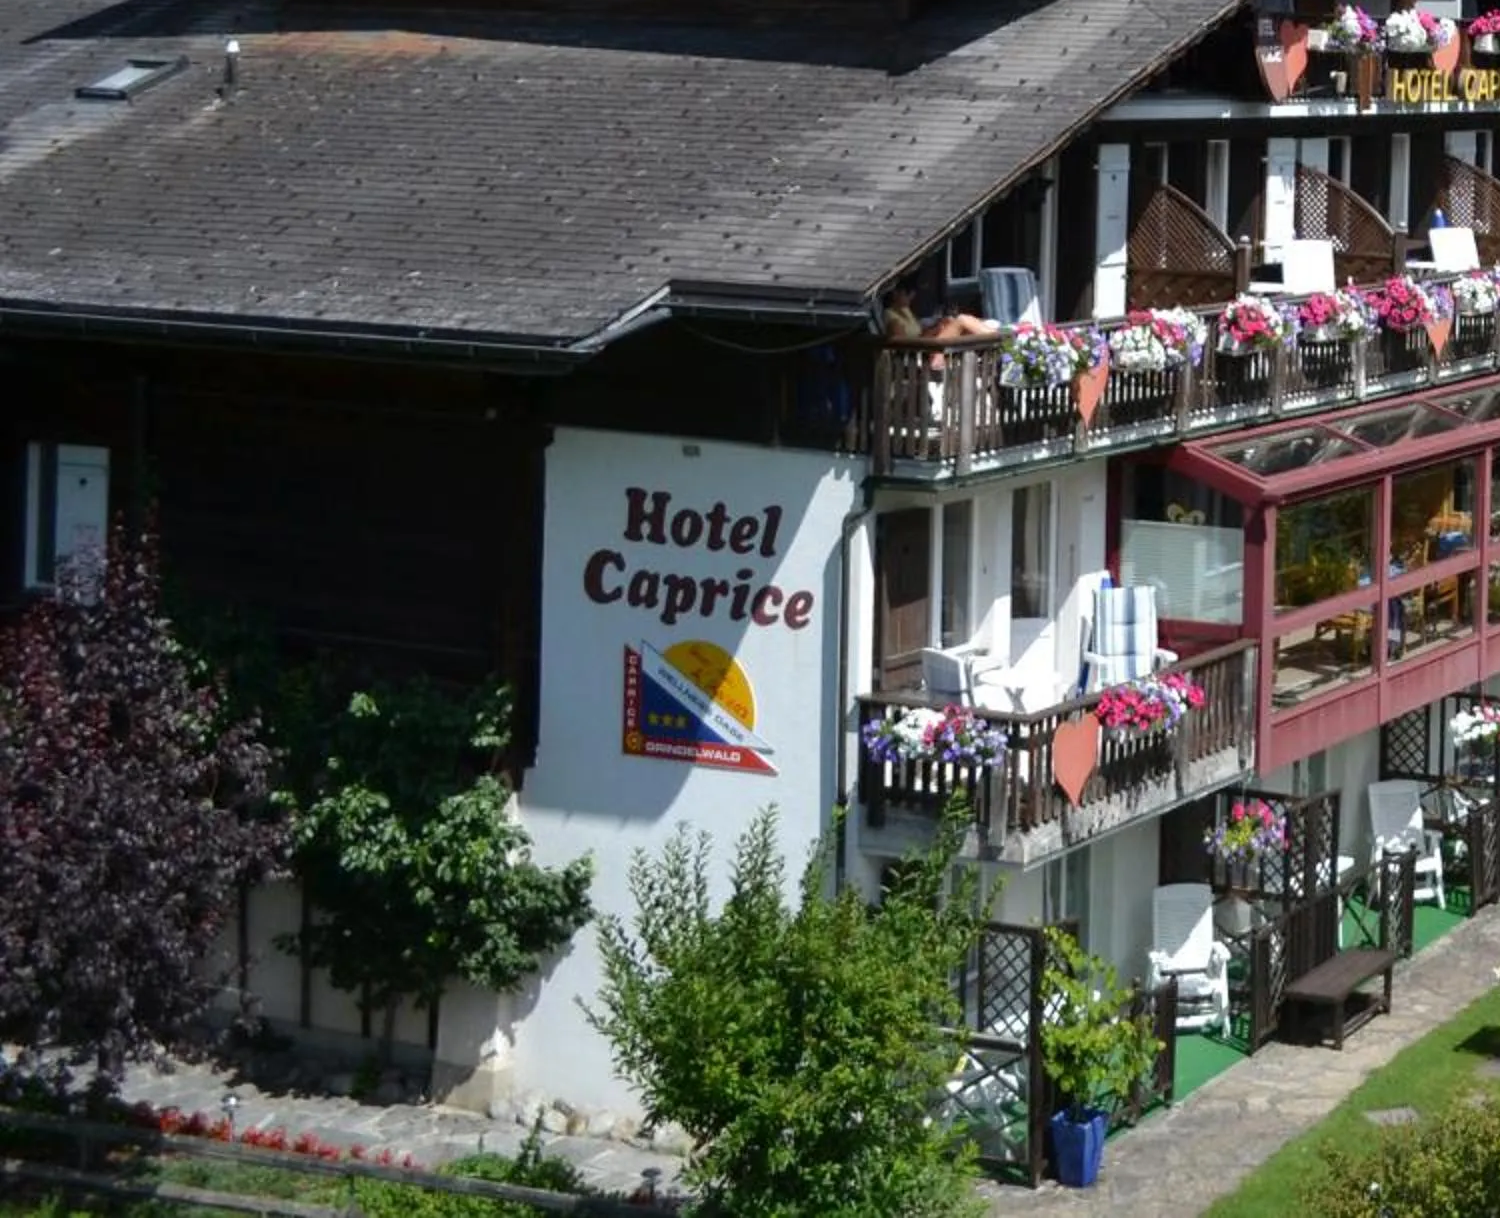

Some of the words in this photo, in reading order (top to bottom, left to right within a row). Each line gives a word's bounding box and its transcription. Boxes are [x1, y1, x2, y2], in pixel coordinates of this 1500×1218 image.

[1393, 68, 1459, 102] HOTEL
[623, 487, 783, 558] Hotel
[583, 549, 814, 630] Caprice
[645, 742, 741, 763] GRINDELWALD
